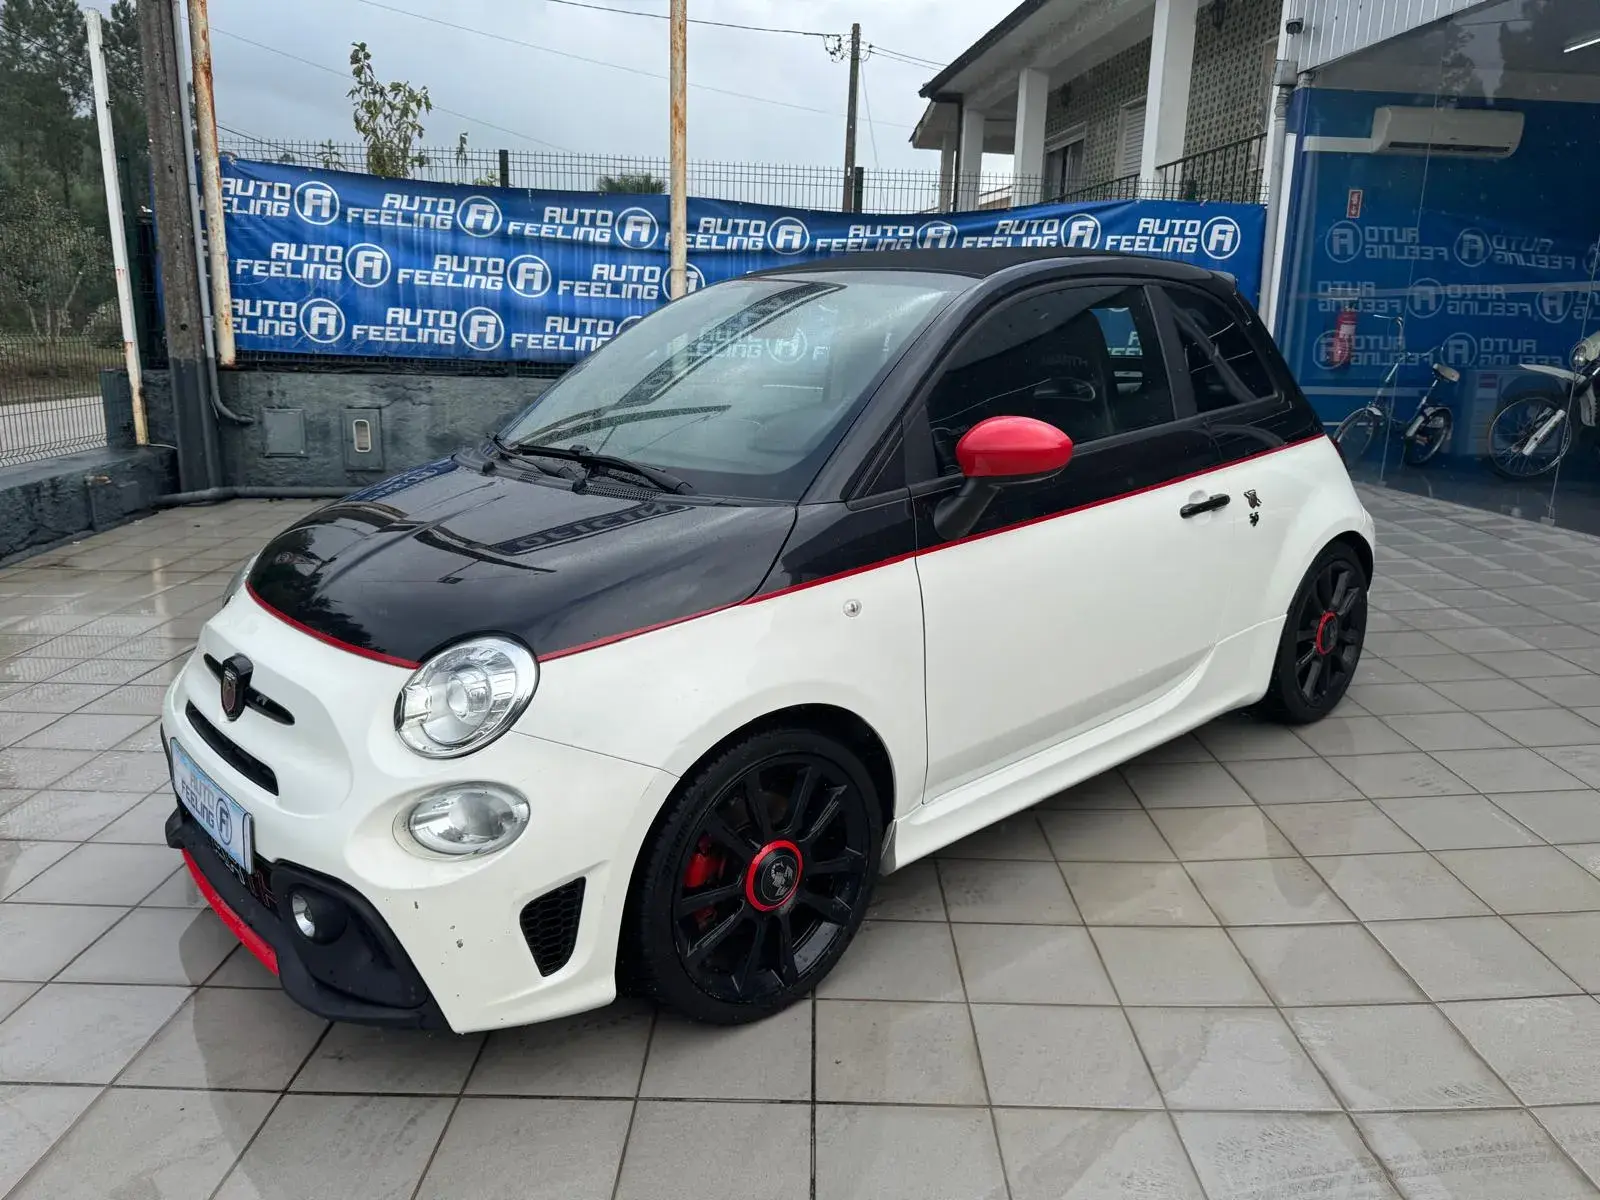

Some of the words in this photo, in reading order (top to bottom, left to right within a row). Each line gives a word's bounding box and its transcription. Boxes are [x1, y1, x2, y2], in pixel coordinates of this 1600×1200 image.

[221, 178, 291, 200] AUTO
[222, 199, 290, 217] ELING
[382, 193, 455, 214] AUTO
[347, 207, 453, 230] FEELING
[543, 206, 613, 227] AUTO
[698, 217, 766, 236] AUTO
[994, 218, 1060, 235] AUTO
[1138, 217, 1201, 236] AUTO
[507, 221, 611, 242] FEELING
[848, 225, 915, 238] AUTO
[271, 242, 343, 263] AUTO
[815, 238, 913, 252] FEELING
[1105, 235, 1198, 254] FEELING
[236, 259, 342, 281] FEELING
[434, 254, 505, 275] AUTO
[592, 263, 661, 283] AUTO
[397, 268, 503, 290] FEELING
[557, 280, 659, 300] FEELING
[231, 299, 297, 318] AUTO
[386, 307, 457, 328] AUTO
[232, 317, 296, 337] ELING
[352, 324, 456, 345] FEELING
[545, 315, 615, 336] AUTO
[190, 772, 215, 812] AUTO
[181, 780, 214, 829] FEELING
